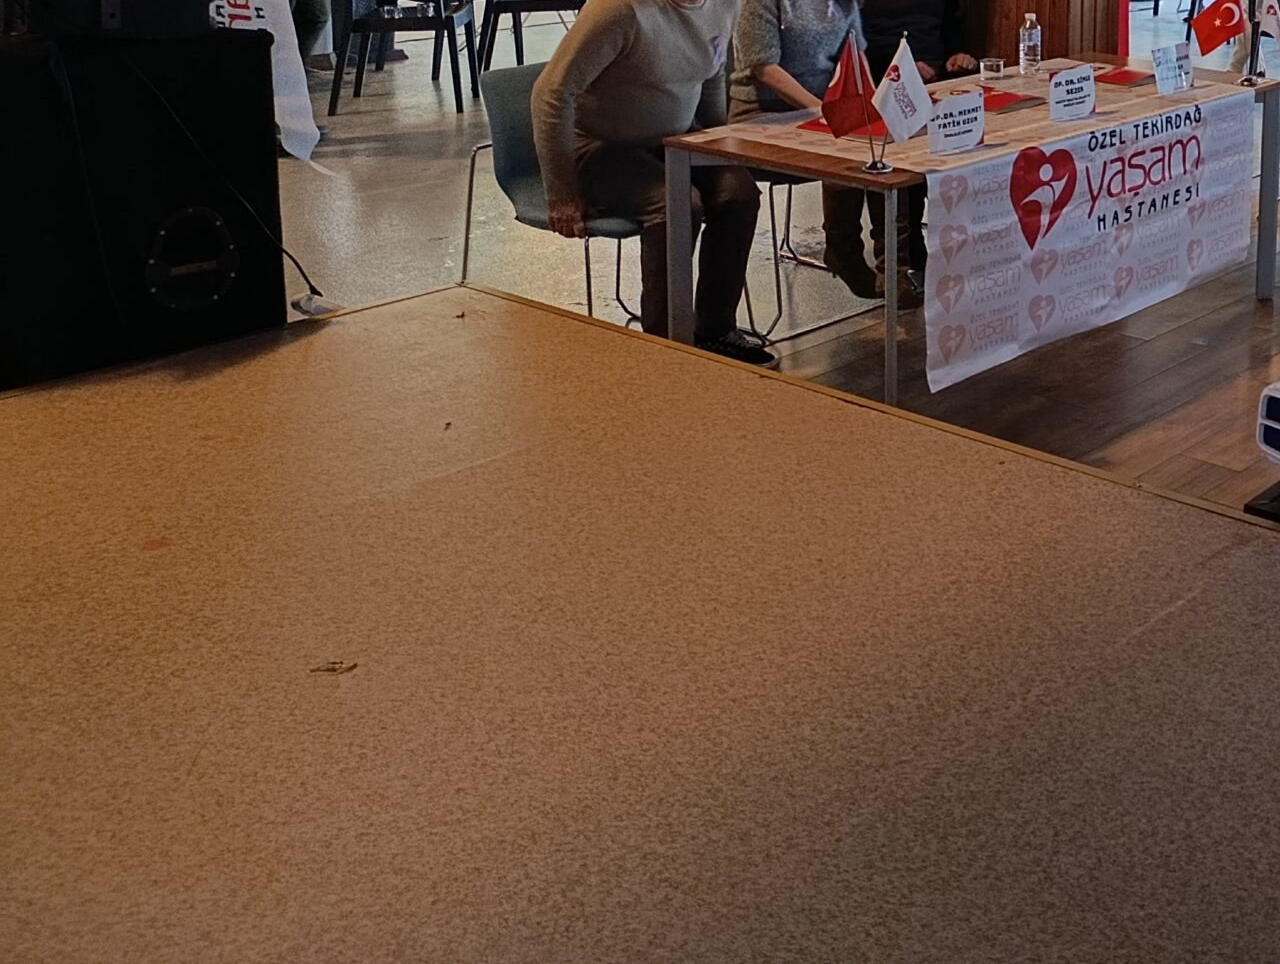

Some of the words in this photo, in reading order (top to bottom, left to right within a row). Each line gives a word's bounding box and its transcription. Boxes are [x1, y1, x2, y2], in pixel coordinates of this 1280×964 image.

[938, 119, 961, 130] FATİH
[958, 106, 982, 117] MEHMET
[1088, 130, 1126, 152] ÖZEL
[1133, 105, 1202, 141] TEKİRDAĞ
[971, 174, 1009, 203] yaşa
[1085, 135, 1201, 220] yaşam
[1097, 183, 1200, 232] HASTANESİ
